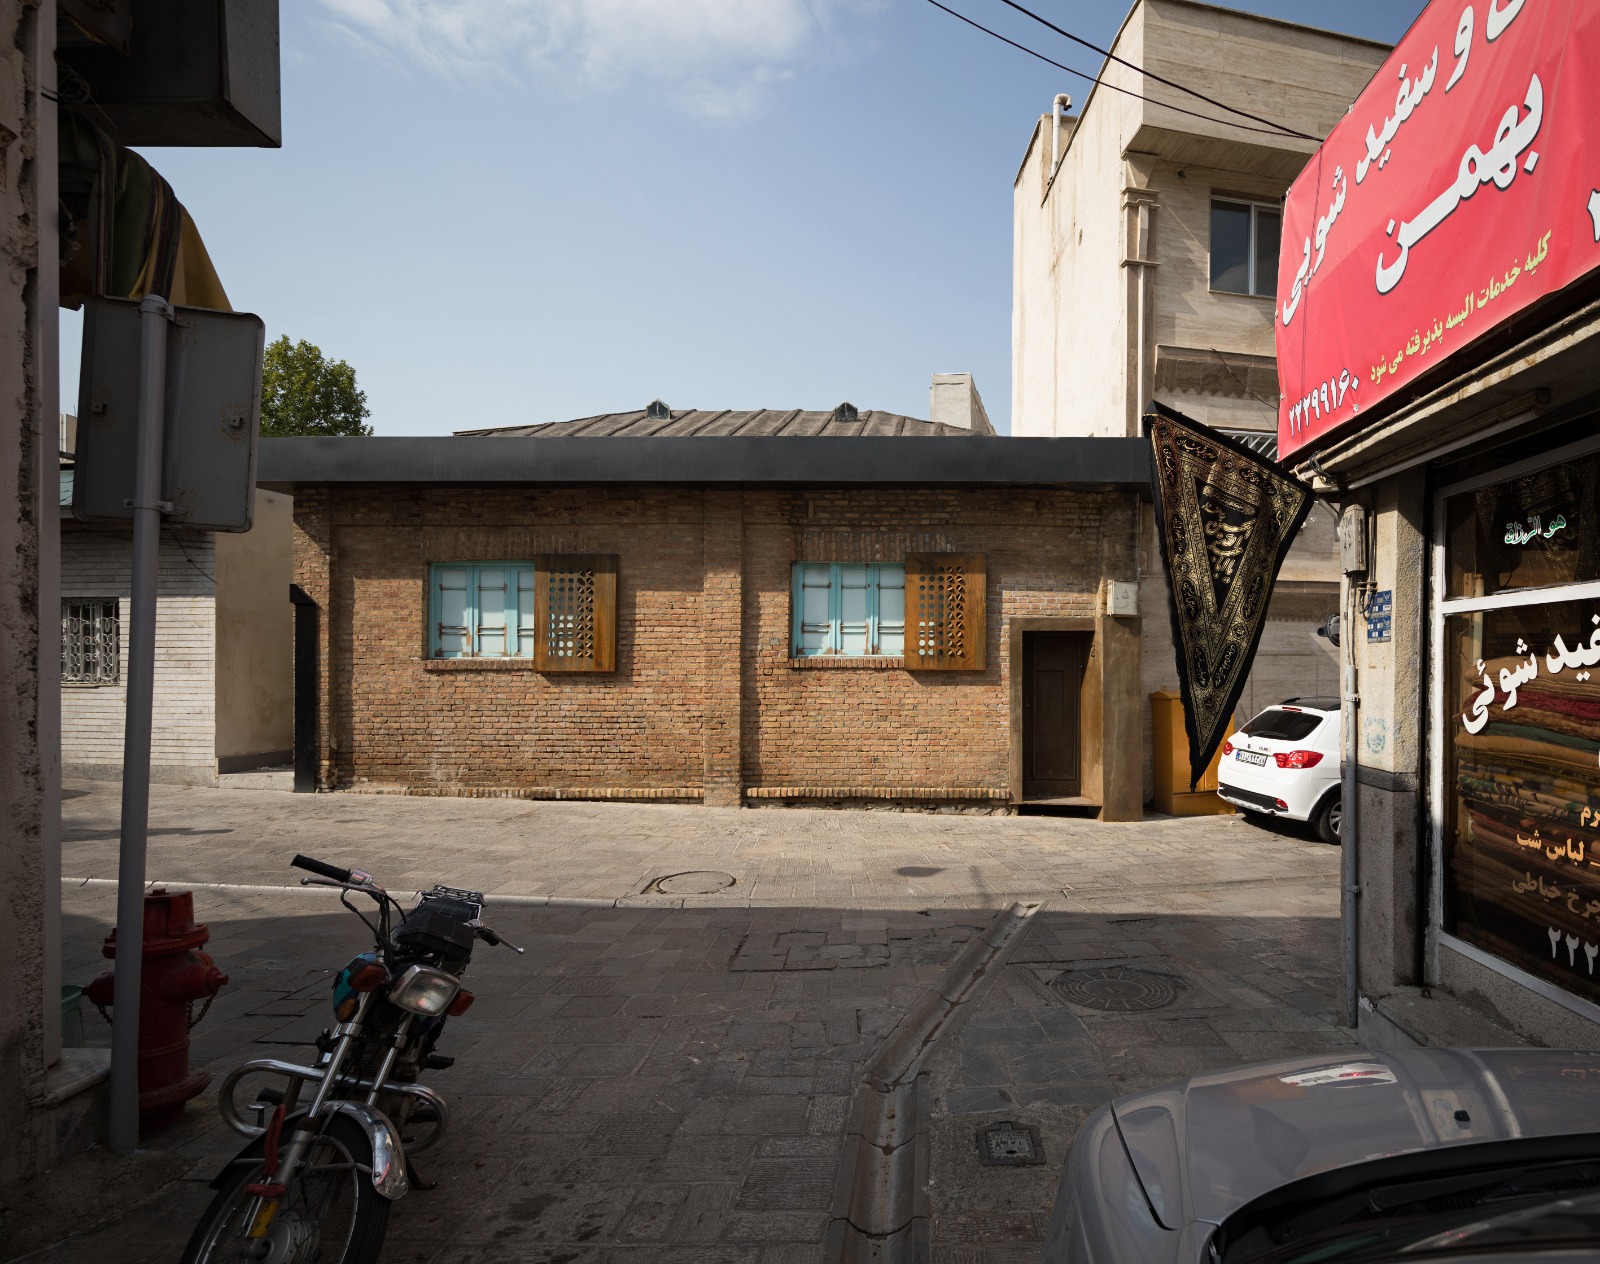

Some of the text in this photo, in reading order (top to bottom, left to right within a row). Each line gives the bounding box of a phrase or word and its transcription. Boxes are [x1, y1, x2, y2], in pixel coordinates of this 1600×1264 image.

[1282, 5, 1474, 326] و سفید شویی
[1375, 73, 1544, 295] بهمن
[1370, 229, 1552, 385] کلیه خدمات البسه پذیرفته می شود
[1543, 514, 1566, 538] هو
[1512, 871, 1562, 902] خیاطی
[1516, 829, 1584, 866] لباس شب
